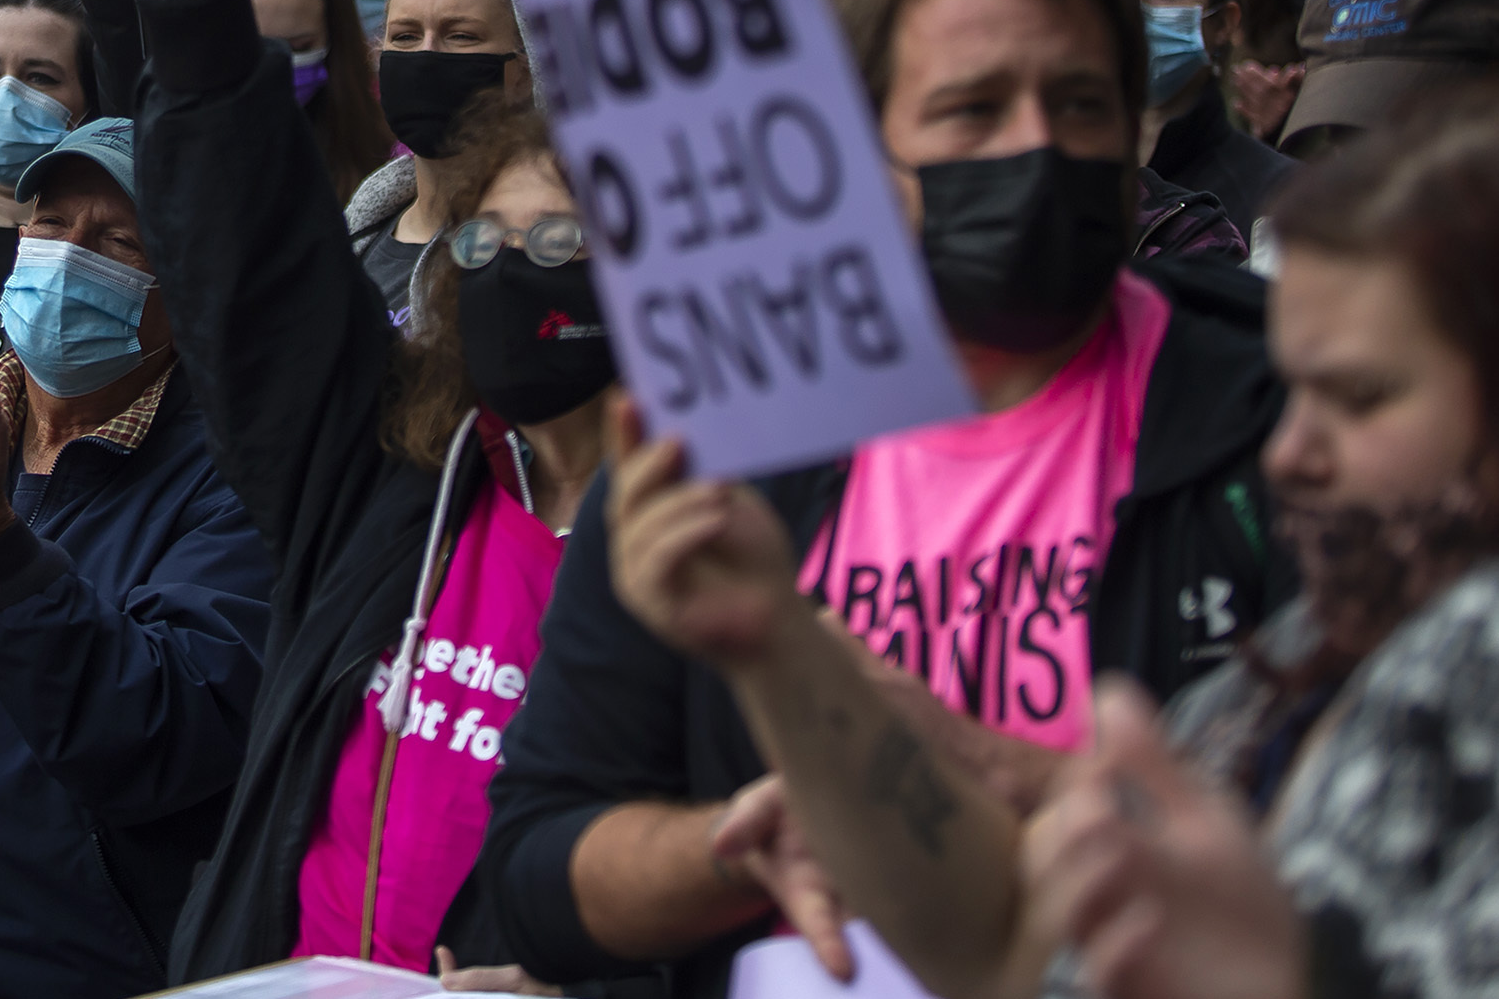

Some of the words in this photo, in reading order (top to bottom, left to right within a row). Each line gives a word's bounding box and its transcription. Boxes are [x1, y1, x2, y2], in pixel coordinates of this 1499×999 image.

[657, 94, 843, 254] OFF
[637, 244, 905, 411] BANS
[843, 536, 1092, 631] RAISING
[449, 707, 505, 765] fo
